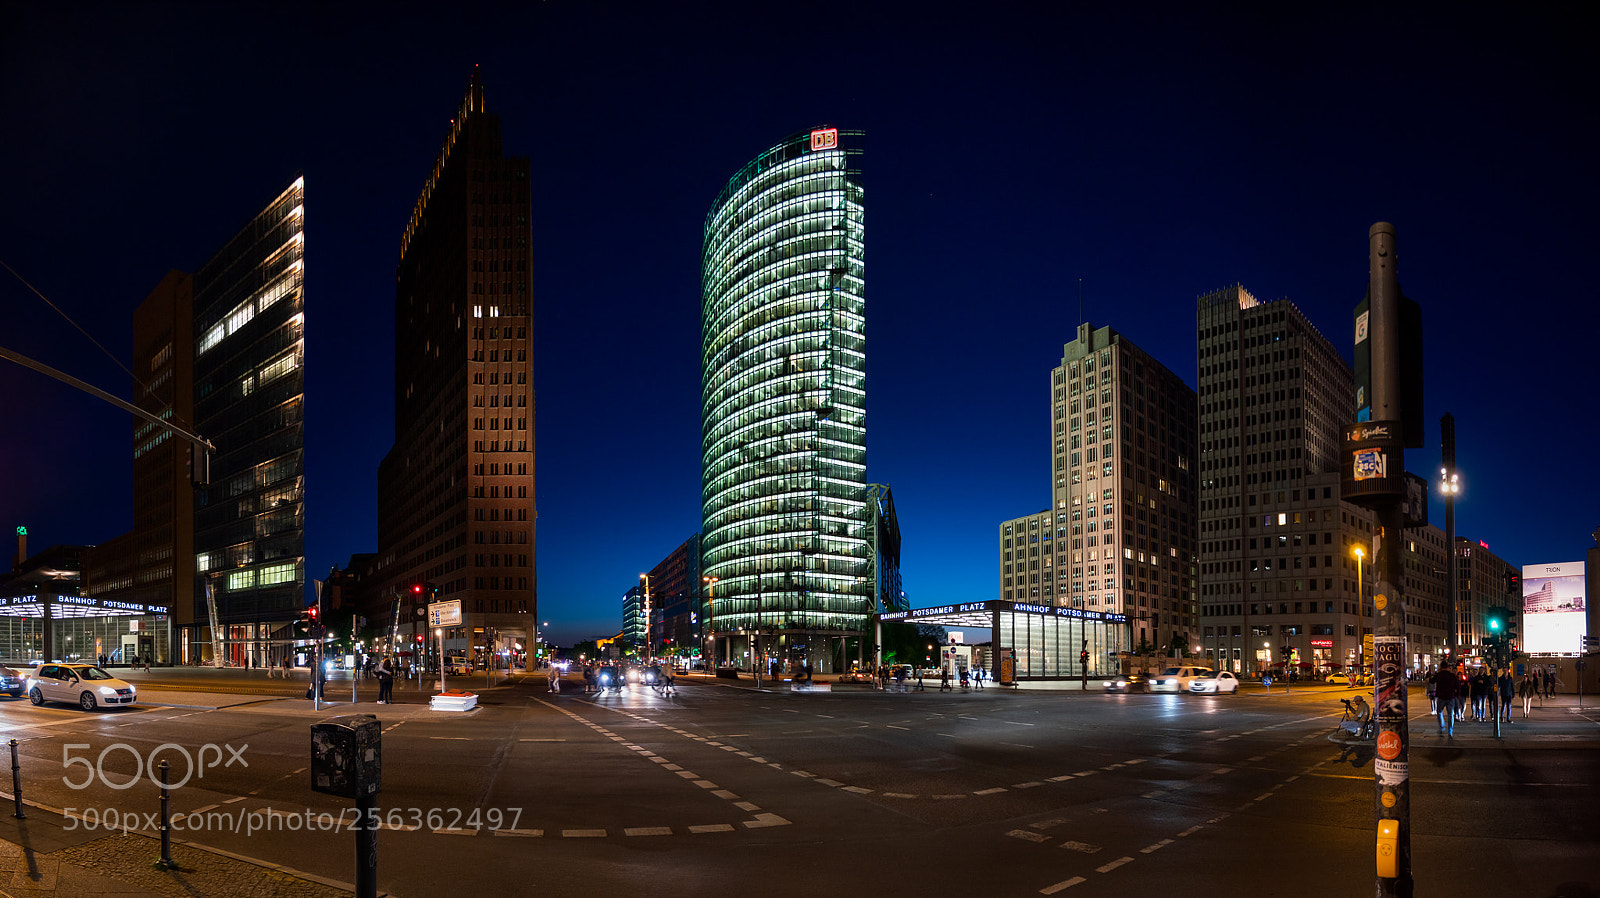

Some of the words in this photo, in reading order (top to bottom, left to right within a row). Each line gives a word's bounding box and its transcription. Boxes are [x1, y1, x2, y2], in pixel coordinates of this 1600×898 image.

[815, 132, 834, 148] DB
[13, 595, 37, 604] PLATZ
[58, 595, 97, 606] BAHNHOF
[103, 600, 144, 611] POTSDAMER
[148, 605, 168, 614] PLATZ
[880, 611, 908, 621] BAHNHOF
[912, 606, 954, 617] POTSDAMER
[960, 603, 985, 612] PLATZ
